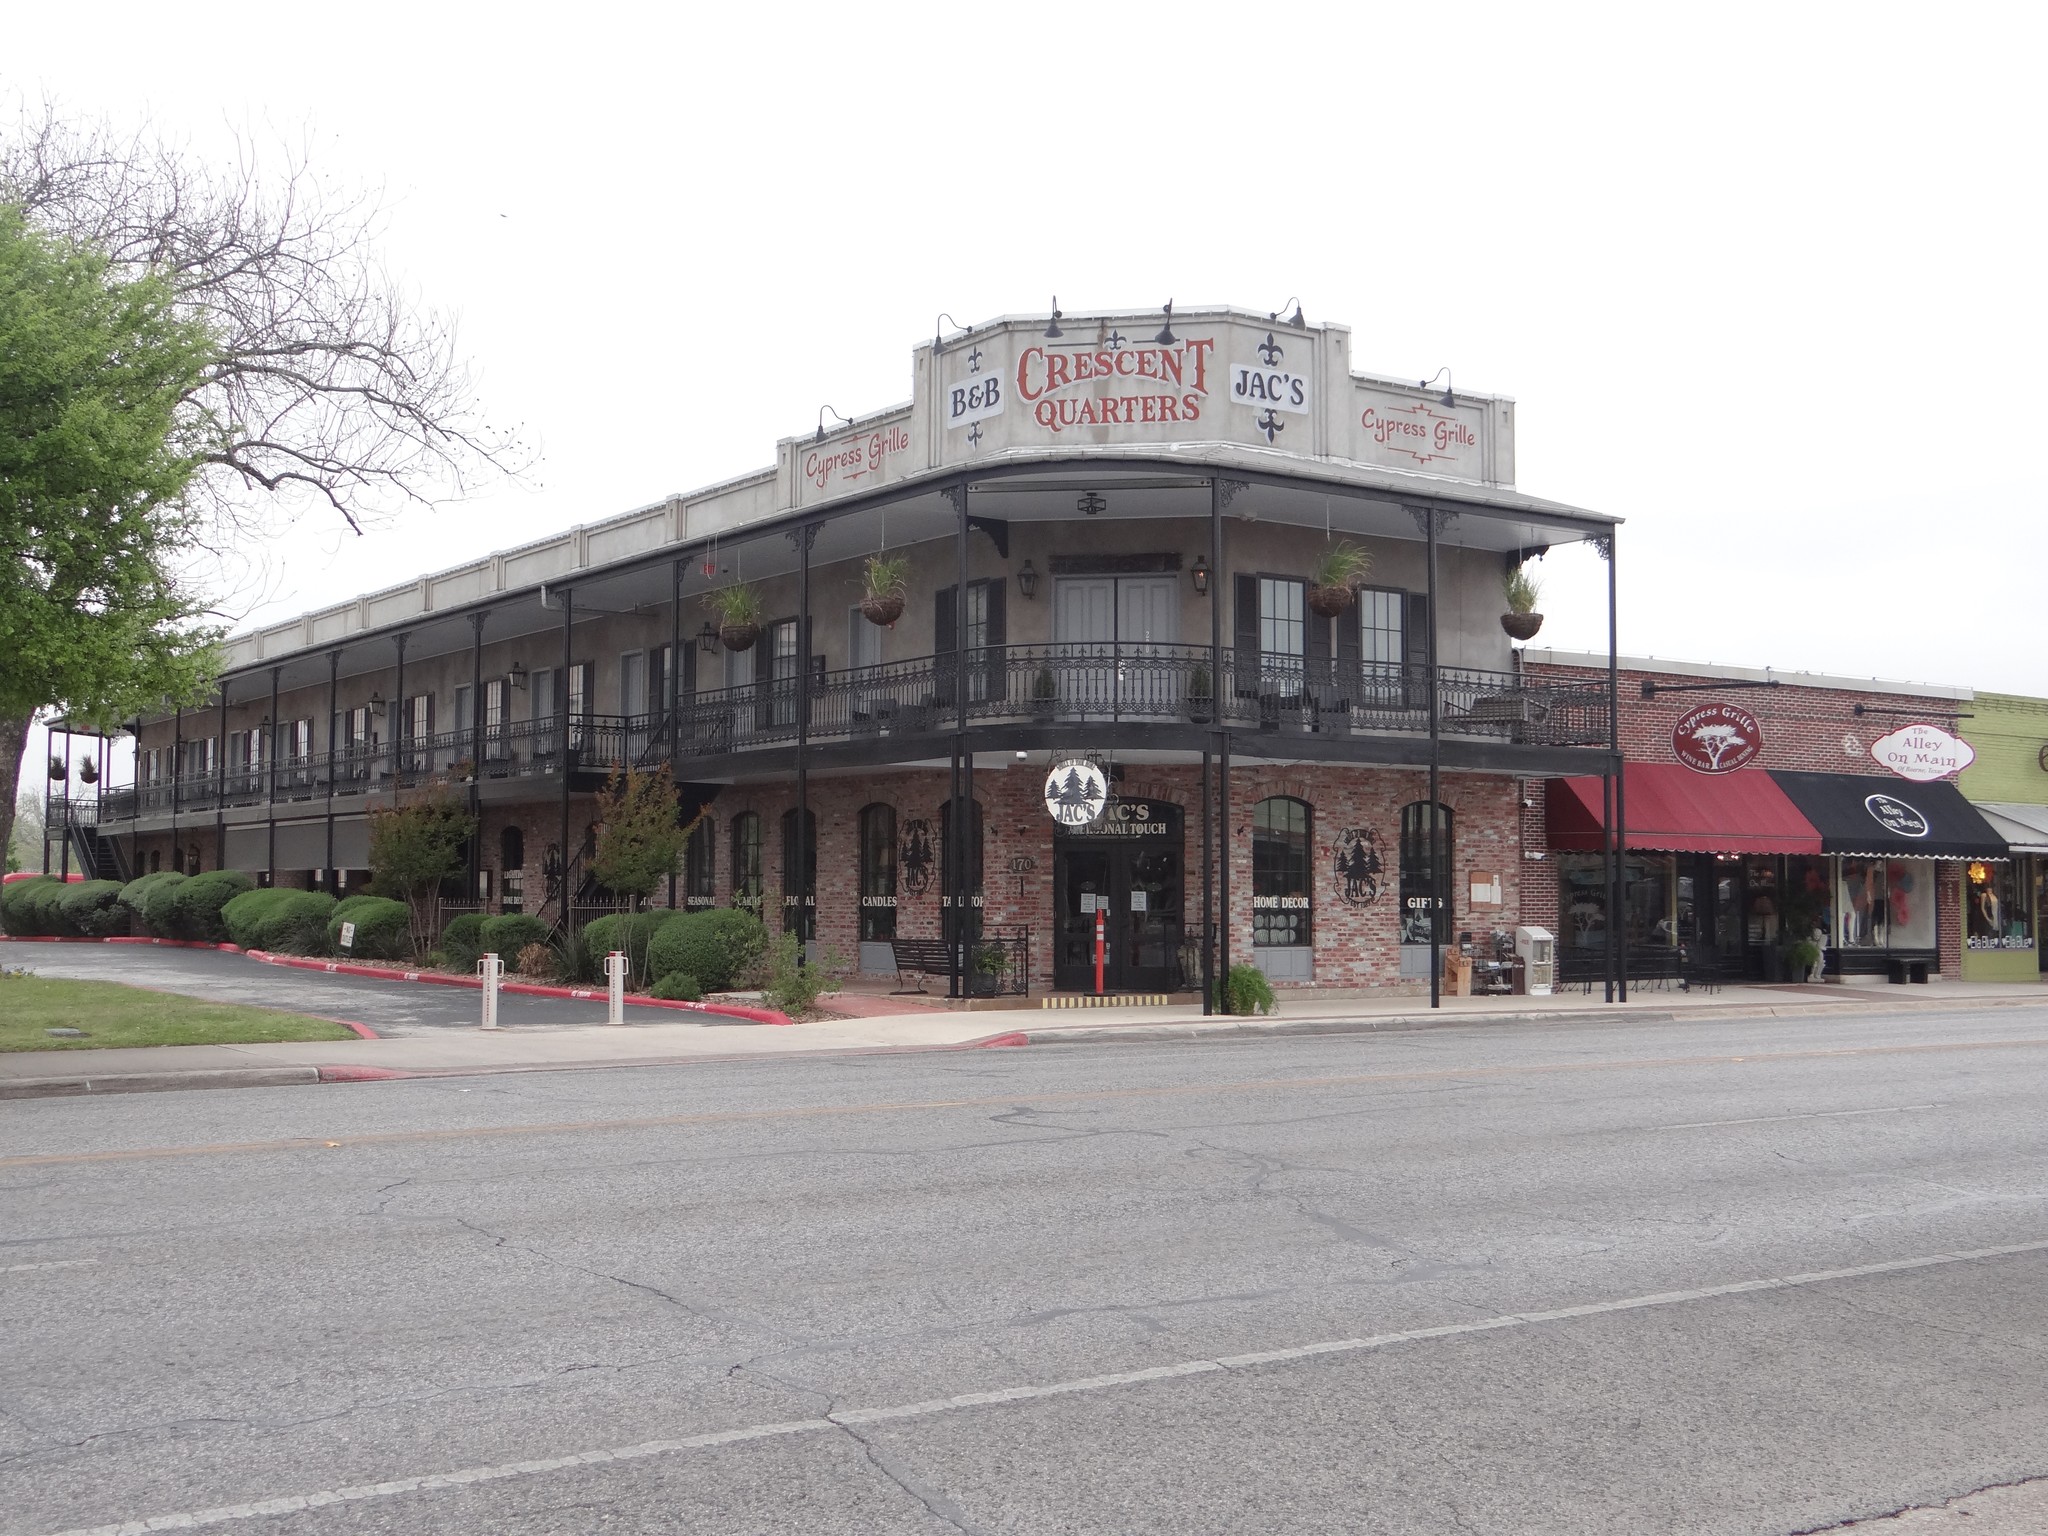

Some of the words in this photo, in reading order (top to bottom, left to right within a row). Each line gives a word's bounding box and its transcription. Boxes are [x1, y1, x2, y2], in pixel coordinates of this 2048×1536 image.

[1017, 337, 1214, 401] CRESCENT
[1236, 370, 1304, 405] JAC'S
[952, 377, 1000, 418] B&B
[1034, 393, 1200, 432] QUARTERS
[1361, 408, 1426, 442] Cypress
[1434, 421, 1475, 450] Grille
[806, 447, 862, 488] Cypress
[868, 427, 909, 470] Grille
[1677, 707, 1717, 735] Cypress
[1721, 707, 1754, 733] Grille
[1902, 738, 1943, 751] Alley
[1680, 750, 1696, 766] WINE
[1697, 760, 1710, 770] BAR
[1887, 752, 1908, 764] On
[1914, 754, 1957, 768] Main
[1056, 804, 1096, 823] JAC'S
[1104, 804, 1150, 821] AC'S
[1130, 823, 1167, 835] TOUCH
[1011, 858, 1032, 871] 170
[1345, 878, 1377, 898] JAC'S
[786, 896, 816, 906] FLOAL
[862, 896, 898, 907] CANDLES
[1253, 896, 1279, 908] HOME
[1281, 897, 1310, 909] DECOR
